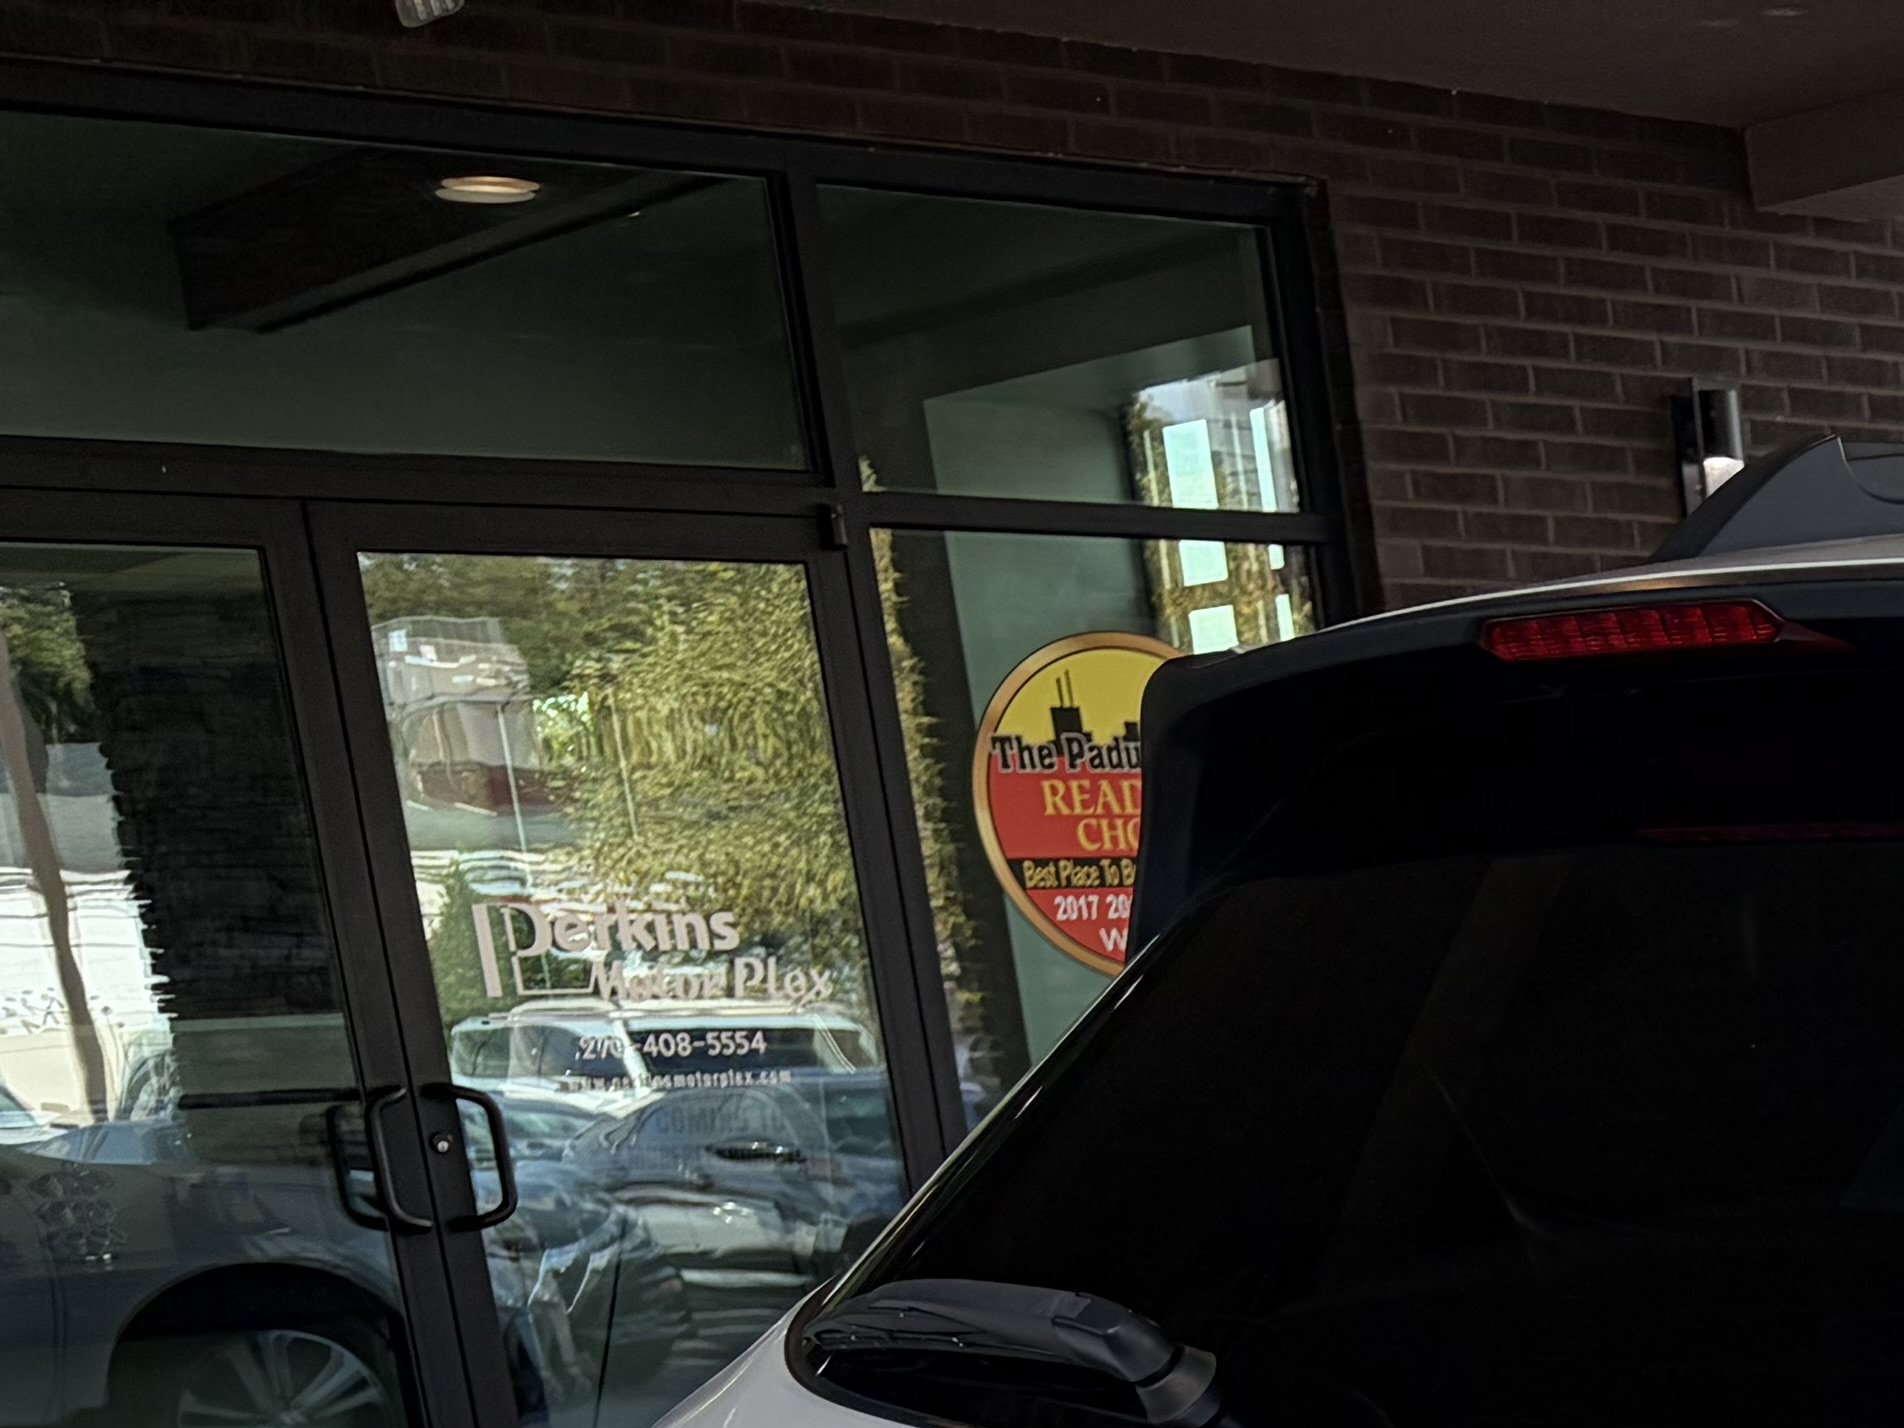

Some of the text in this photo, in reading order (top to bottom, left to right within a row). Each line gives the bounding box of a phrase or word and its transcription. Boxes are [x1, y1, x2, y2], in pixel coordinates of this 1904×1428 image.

[991, 735, 1057, 773] The
[1023, 859, 1058, 888] Best
[1058, 858, 1101, 888] Place
[1100, 858, 1120, 887] To
[1054, 894, 1100, 921] 2017
[472, 899, 740, 997] Perkins
[593, 955, 833, 1009] Motor Plex
